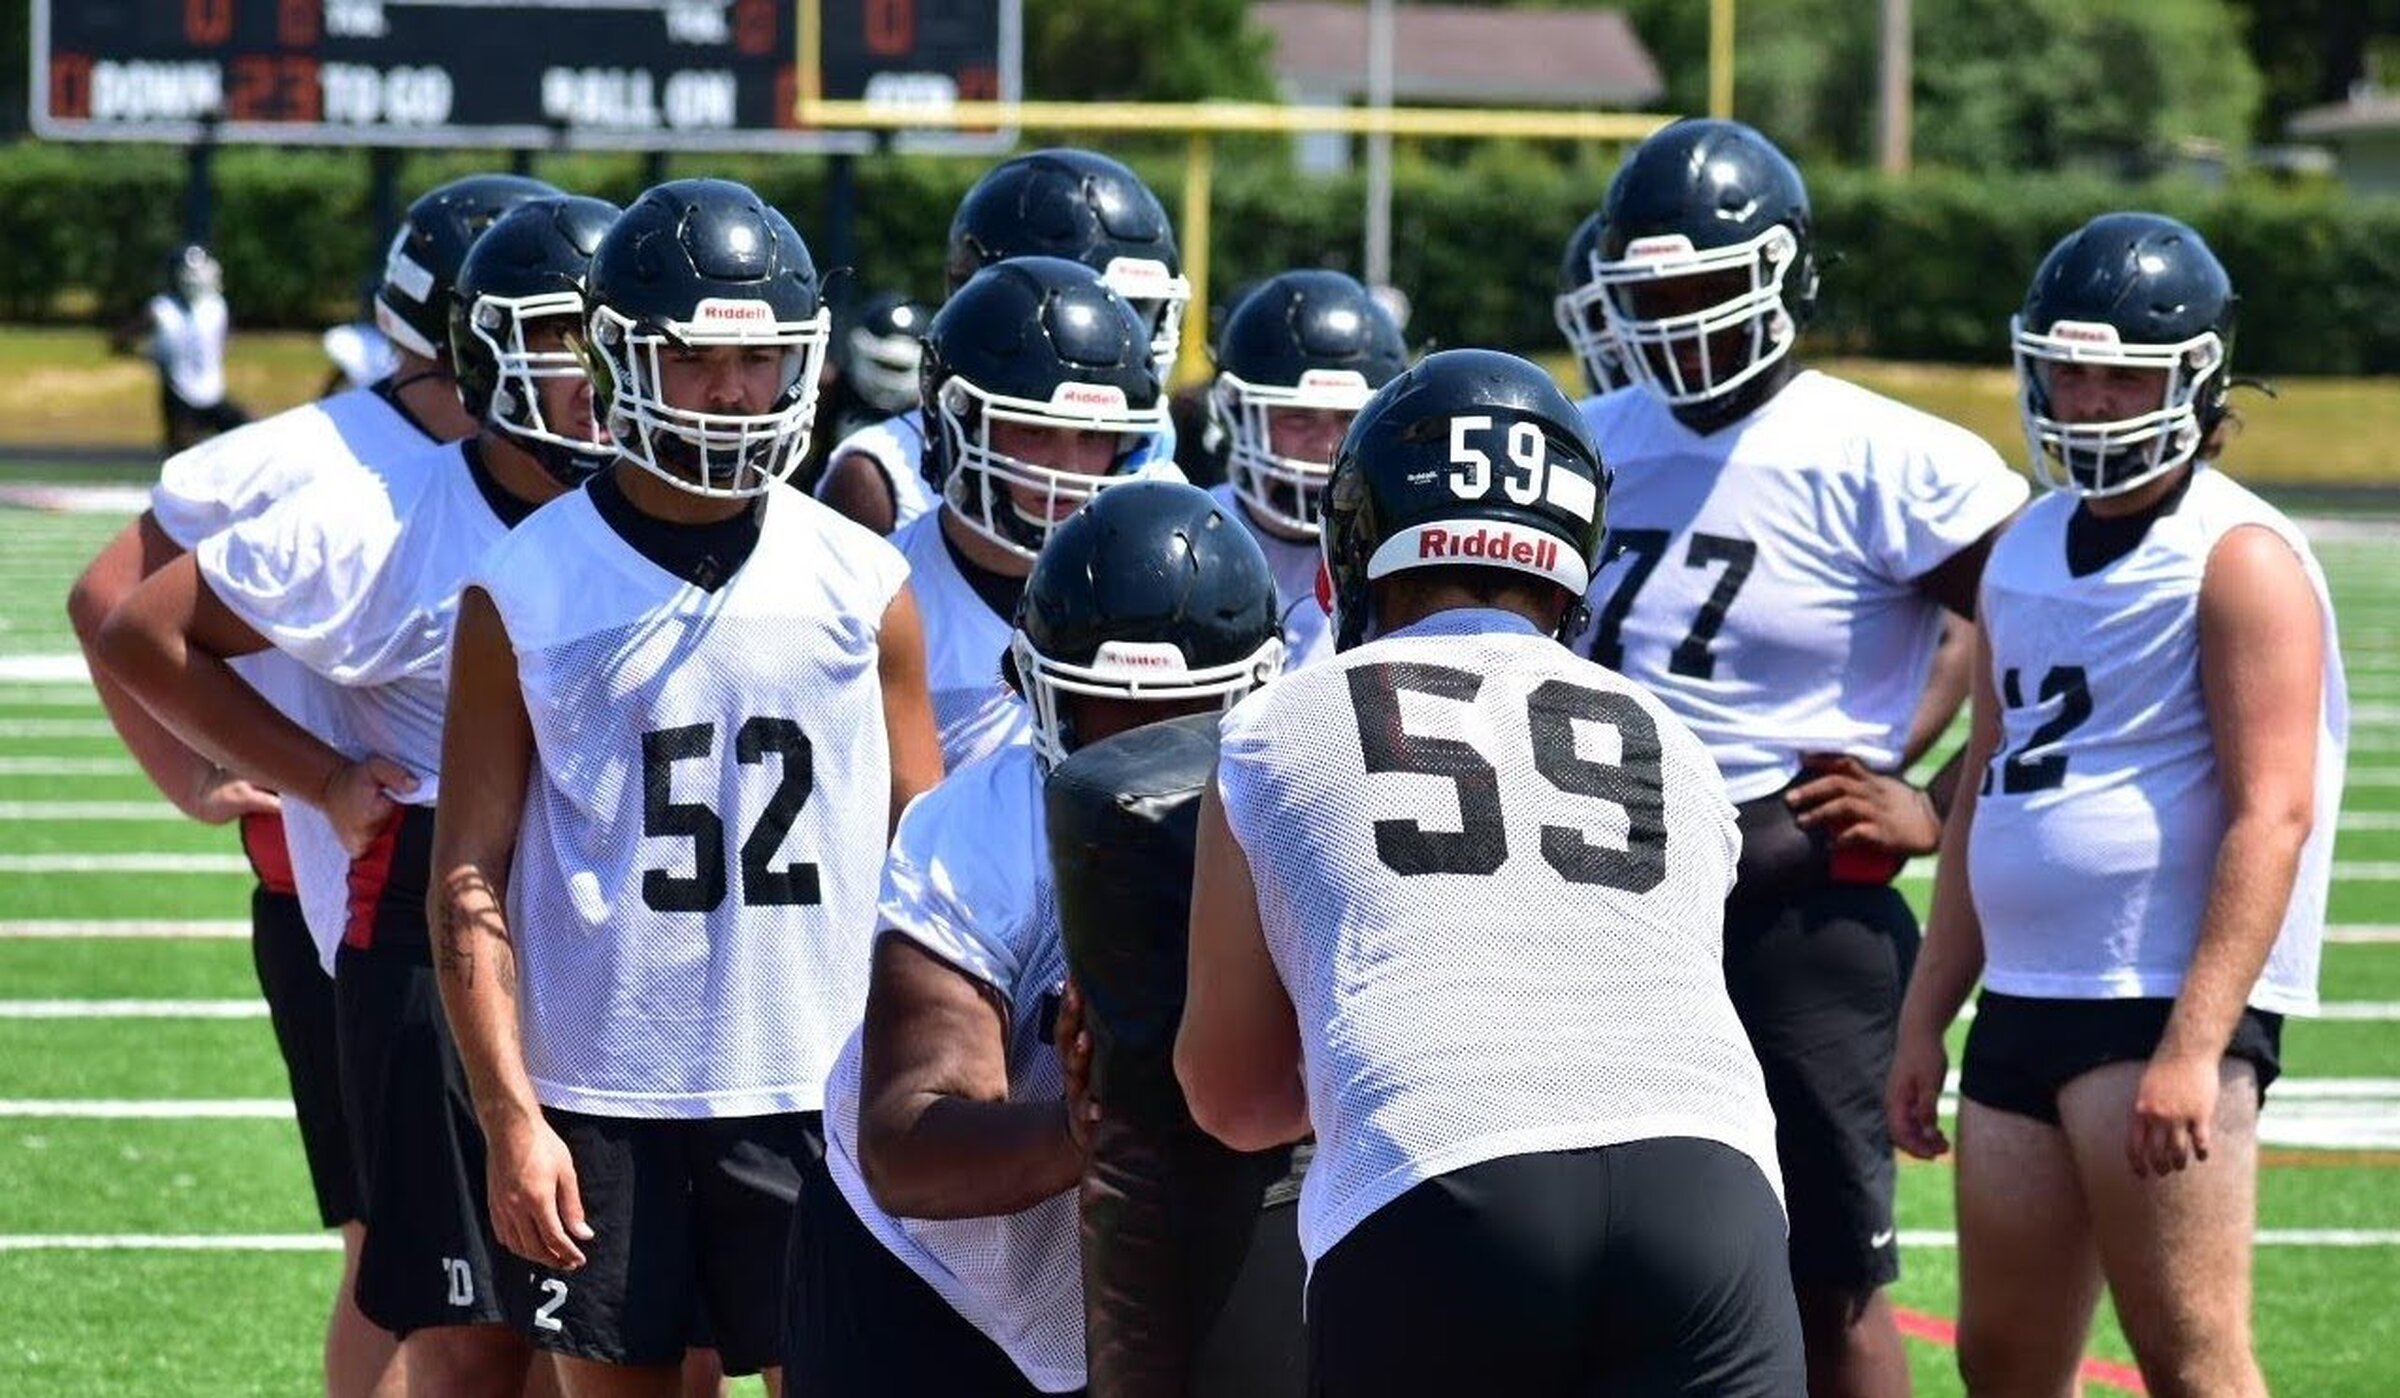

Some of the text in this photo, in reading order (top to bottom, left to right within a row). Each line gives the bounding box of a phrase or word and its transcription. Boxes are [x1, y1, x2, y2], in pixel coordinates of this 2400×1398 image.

[705, 306, 766, 319] Riddell
[1450, 415, 1545, 505] 59
[1418, 529, 1557, 572] Riddell
[1589, 527, 1758, 681] 77
[641, 716, 821, 912] 52
[1345, 661, 1667, 894] 59
[530, 1273, 568, 1332] 2
